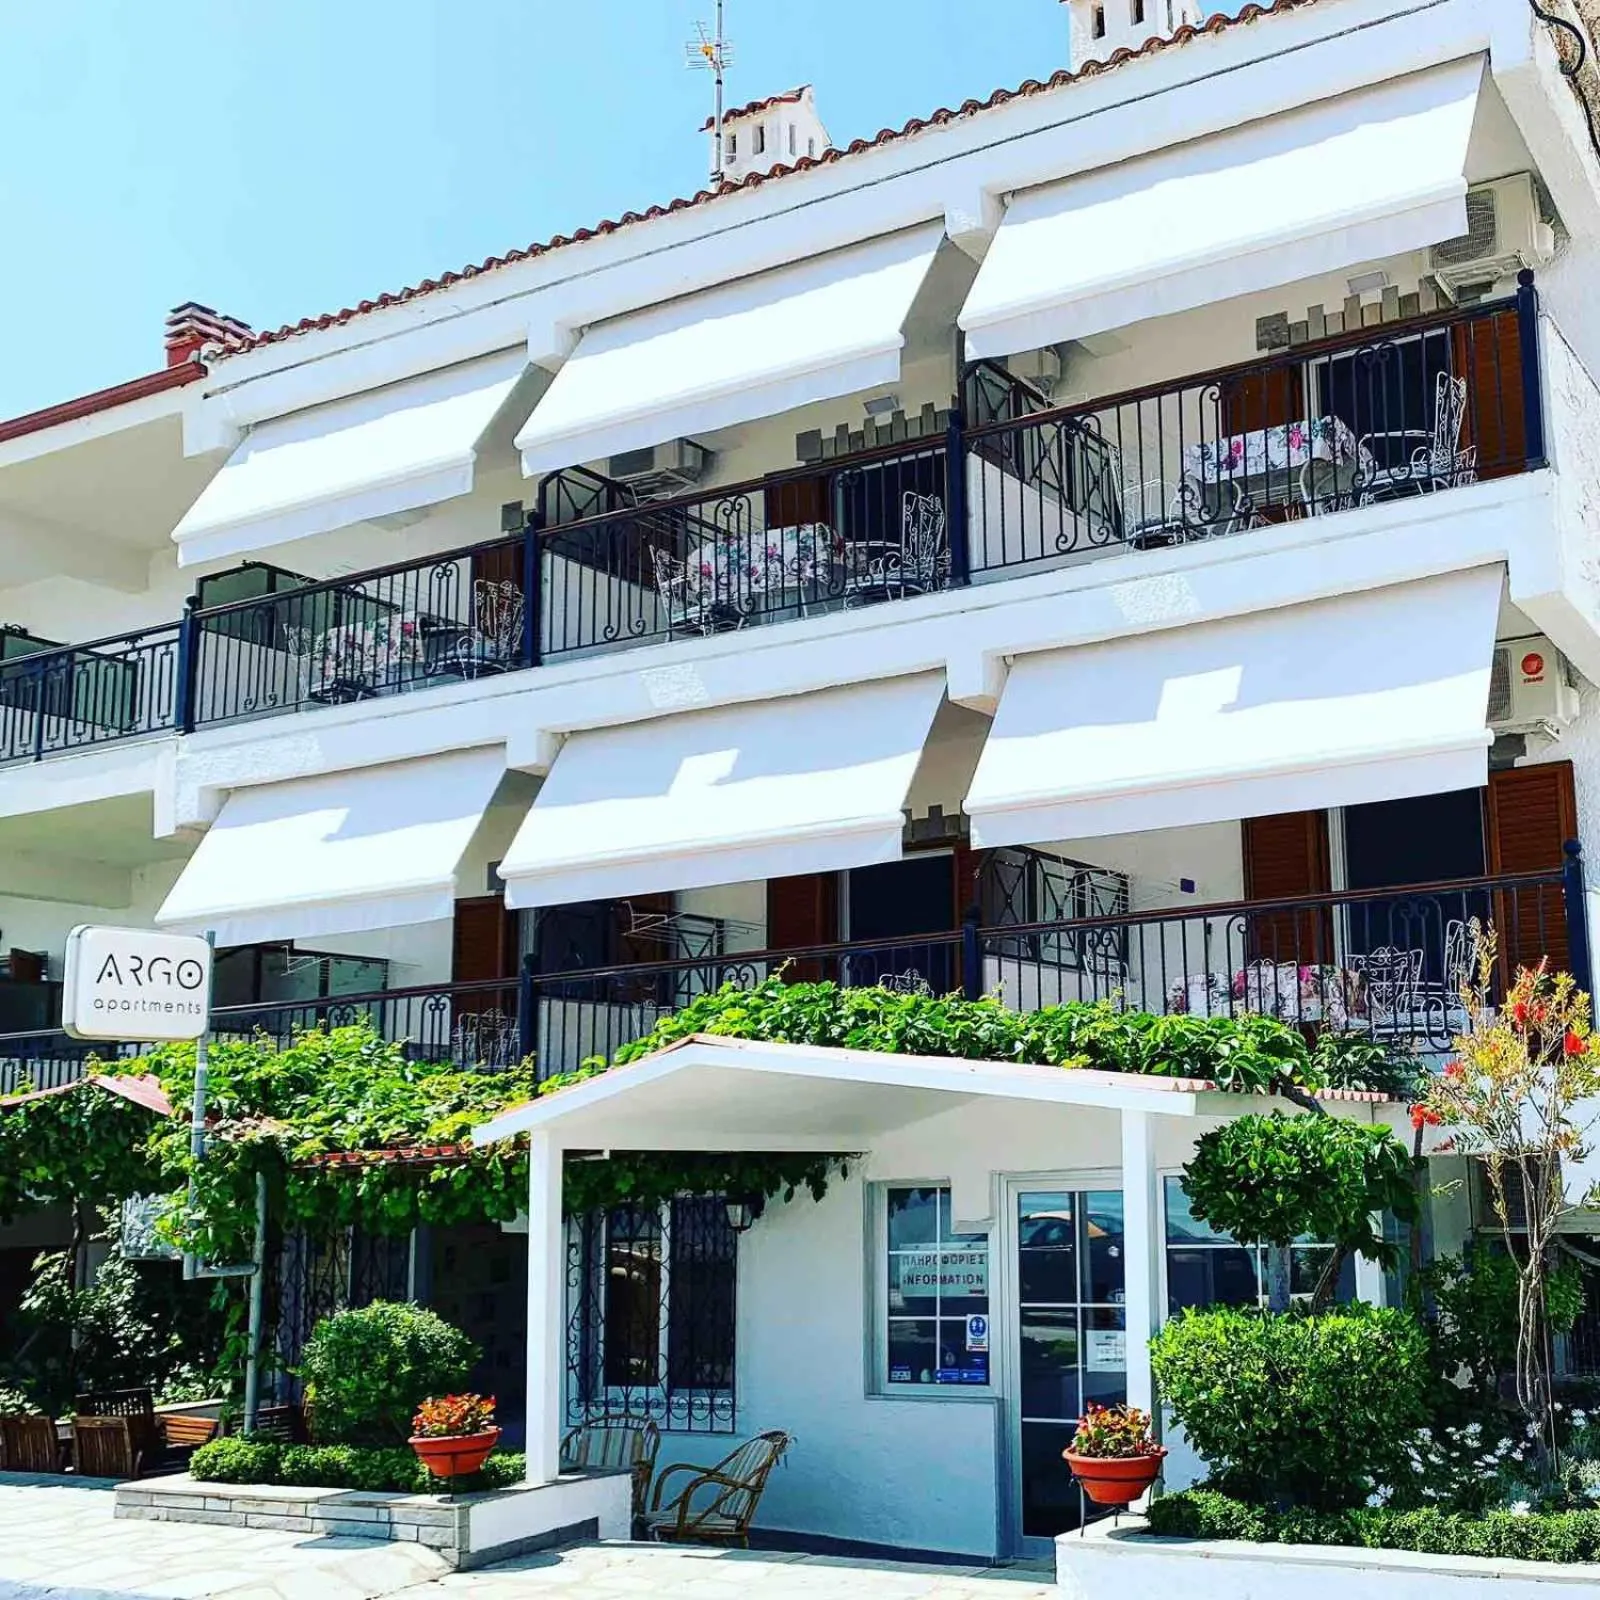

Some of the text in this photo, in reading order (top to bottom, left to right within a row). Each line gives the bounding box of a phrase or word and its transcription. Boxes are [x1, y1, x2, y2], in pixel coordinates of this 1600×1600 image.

[96, 953, 203, 990] ARGO
[93, 998, 201, 1015] apartments
[903, 1273, 984, 1285] INFORMATION
